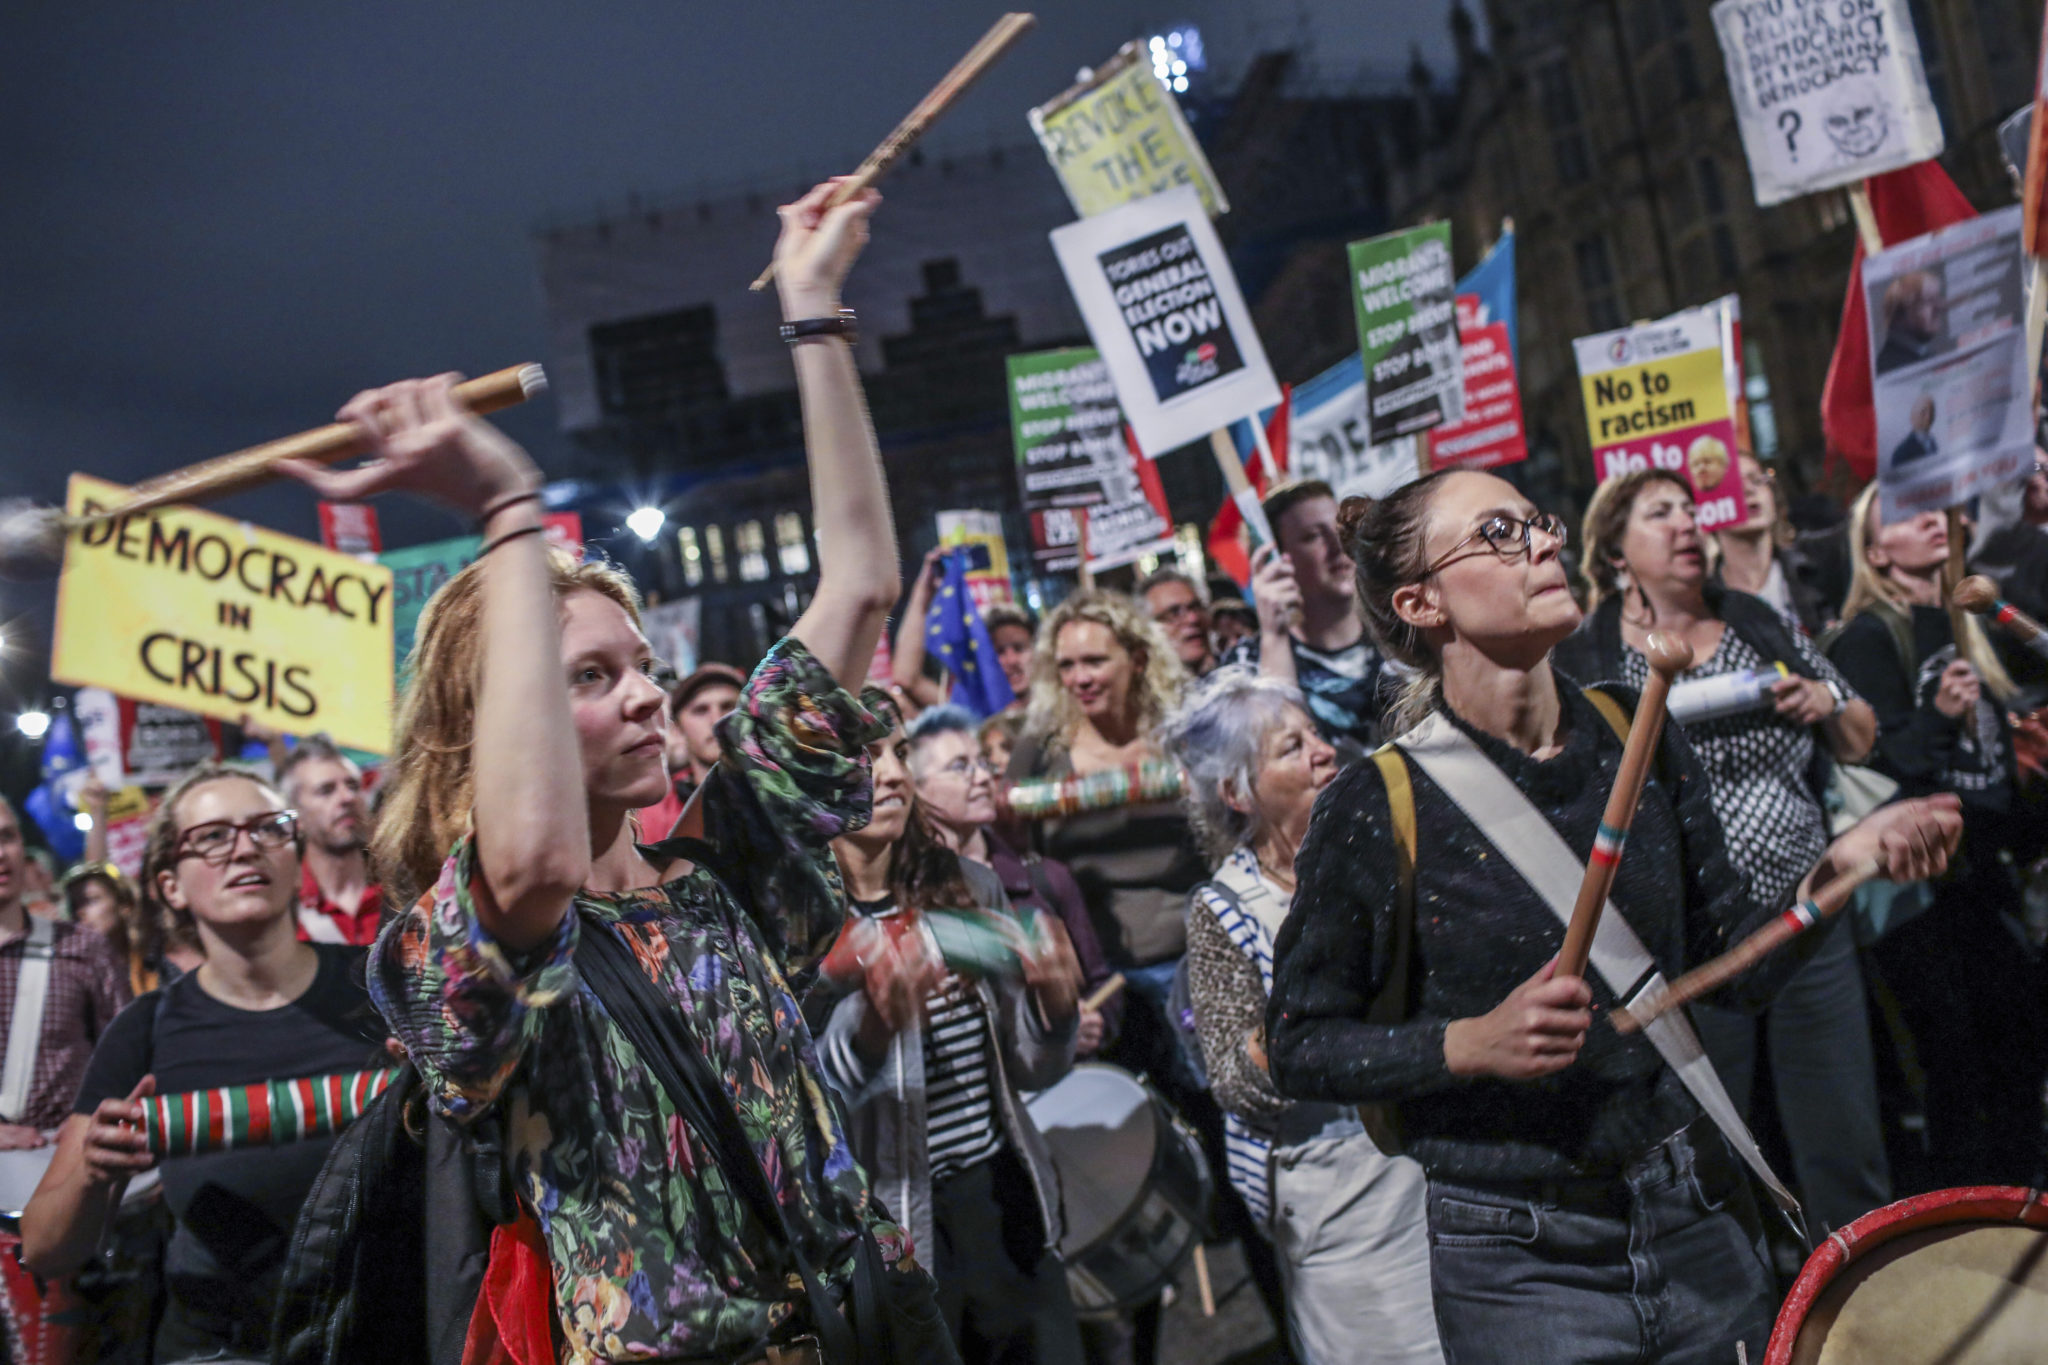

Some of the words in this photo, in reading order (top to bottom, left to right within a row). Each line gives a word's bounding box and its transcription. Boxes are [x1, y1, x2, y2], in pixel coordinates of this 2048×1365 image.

[1092, 126, 1171, 191] THE
[1160, 235, 1192, 263] OUT
[1114, 257, 1206, 306] GENERAL
[1124, 277, 1214, 327] ELECTION
[1362, 265, 1447, 313] WELCOME
[1134, 298, 1223, 358] NOW
[1593, 375, 1634, 407] No
[1641, 368, 1671, 396] to
[1601, 398, 1696, 439] racism
[1651, 442, 1684, 470] to
[82, 498, 386, 625] DEMOCRACY
[216, 601, 251, 630] IN
[138, 632, 318, 718] CRISIS
